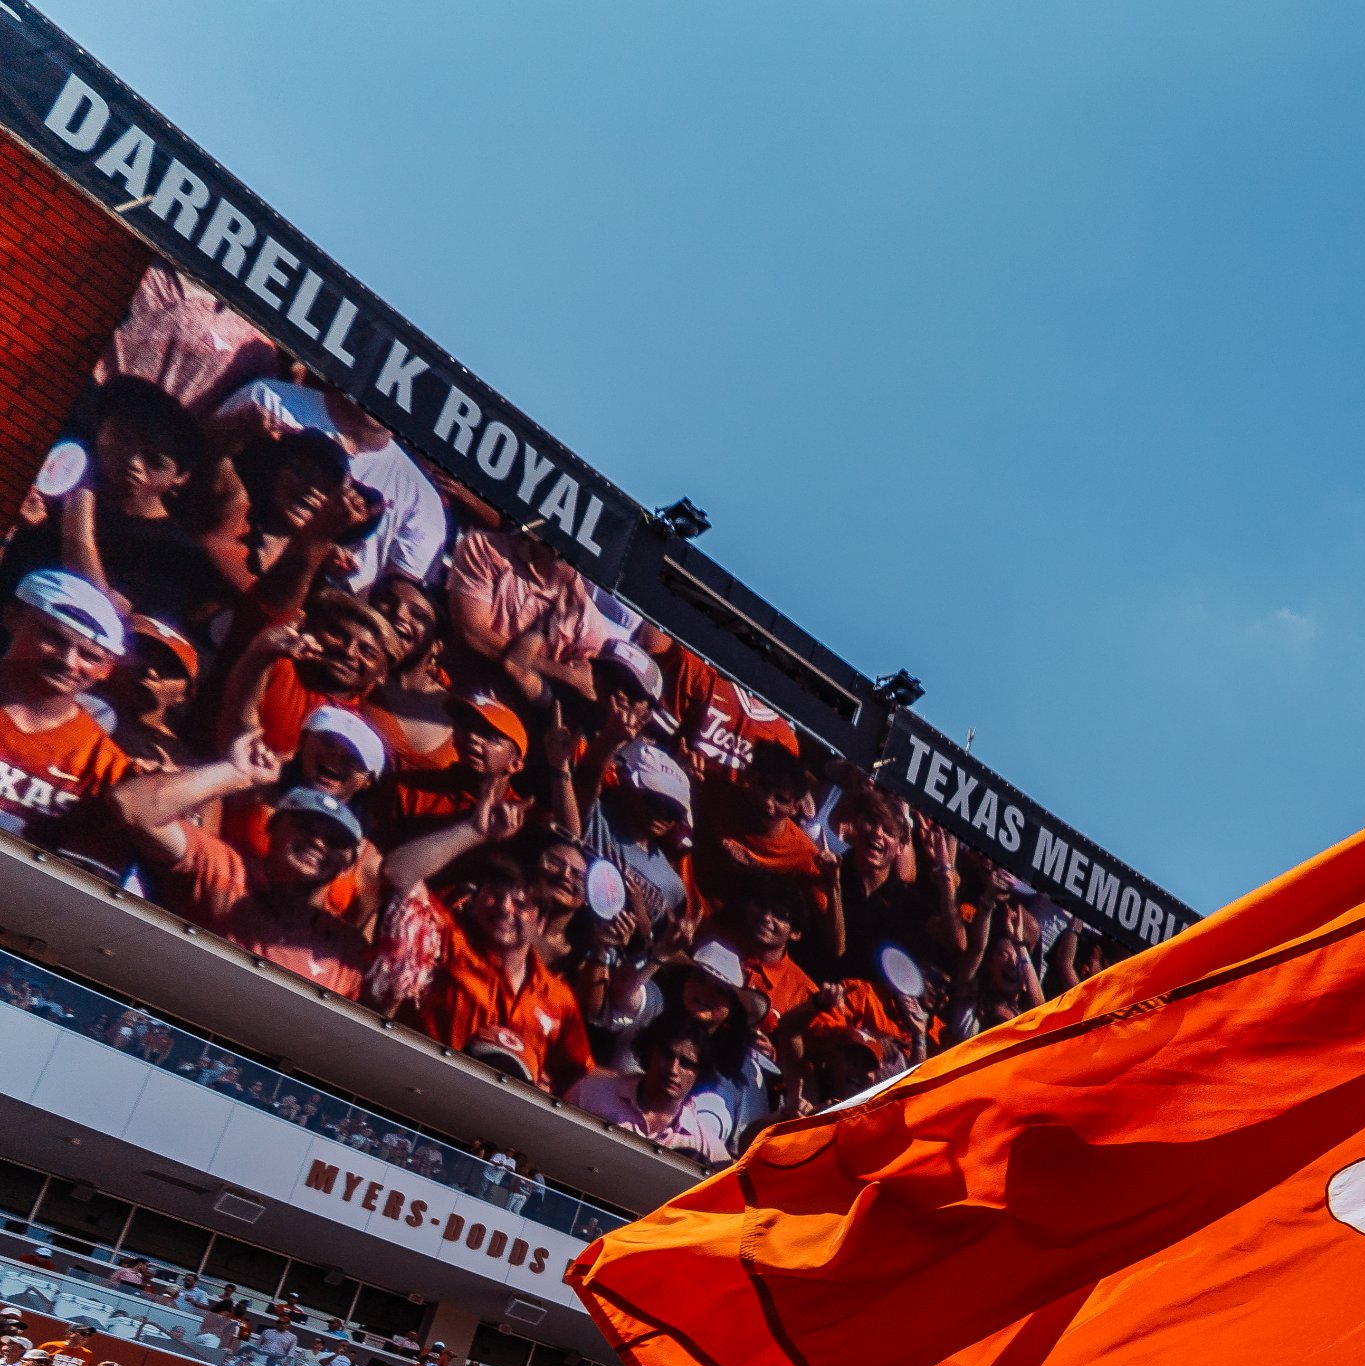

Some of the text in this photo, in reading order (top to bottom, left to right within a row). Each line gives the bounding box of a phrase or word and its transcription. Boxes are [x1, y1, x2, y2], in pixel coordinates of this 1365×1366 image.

[43, 72, 604, 557] DARRELL K ROYAL
[904, 734, 1025, 853] TEXAS
[305, 1159, 550, 1274] MYERS-DODDS
